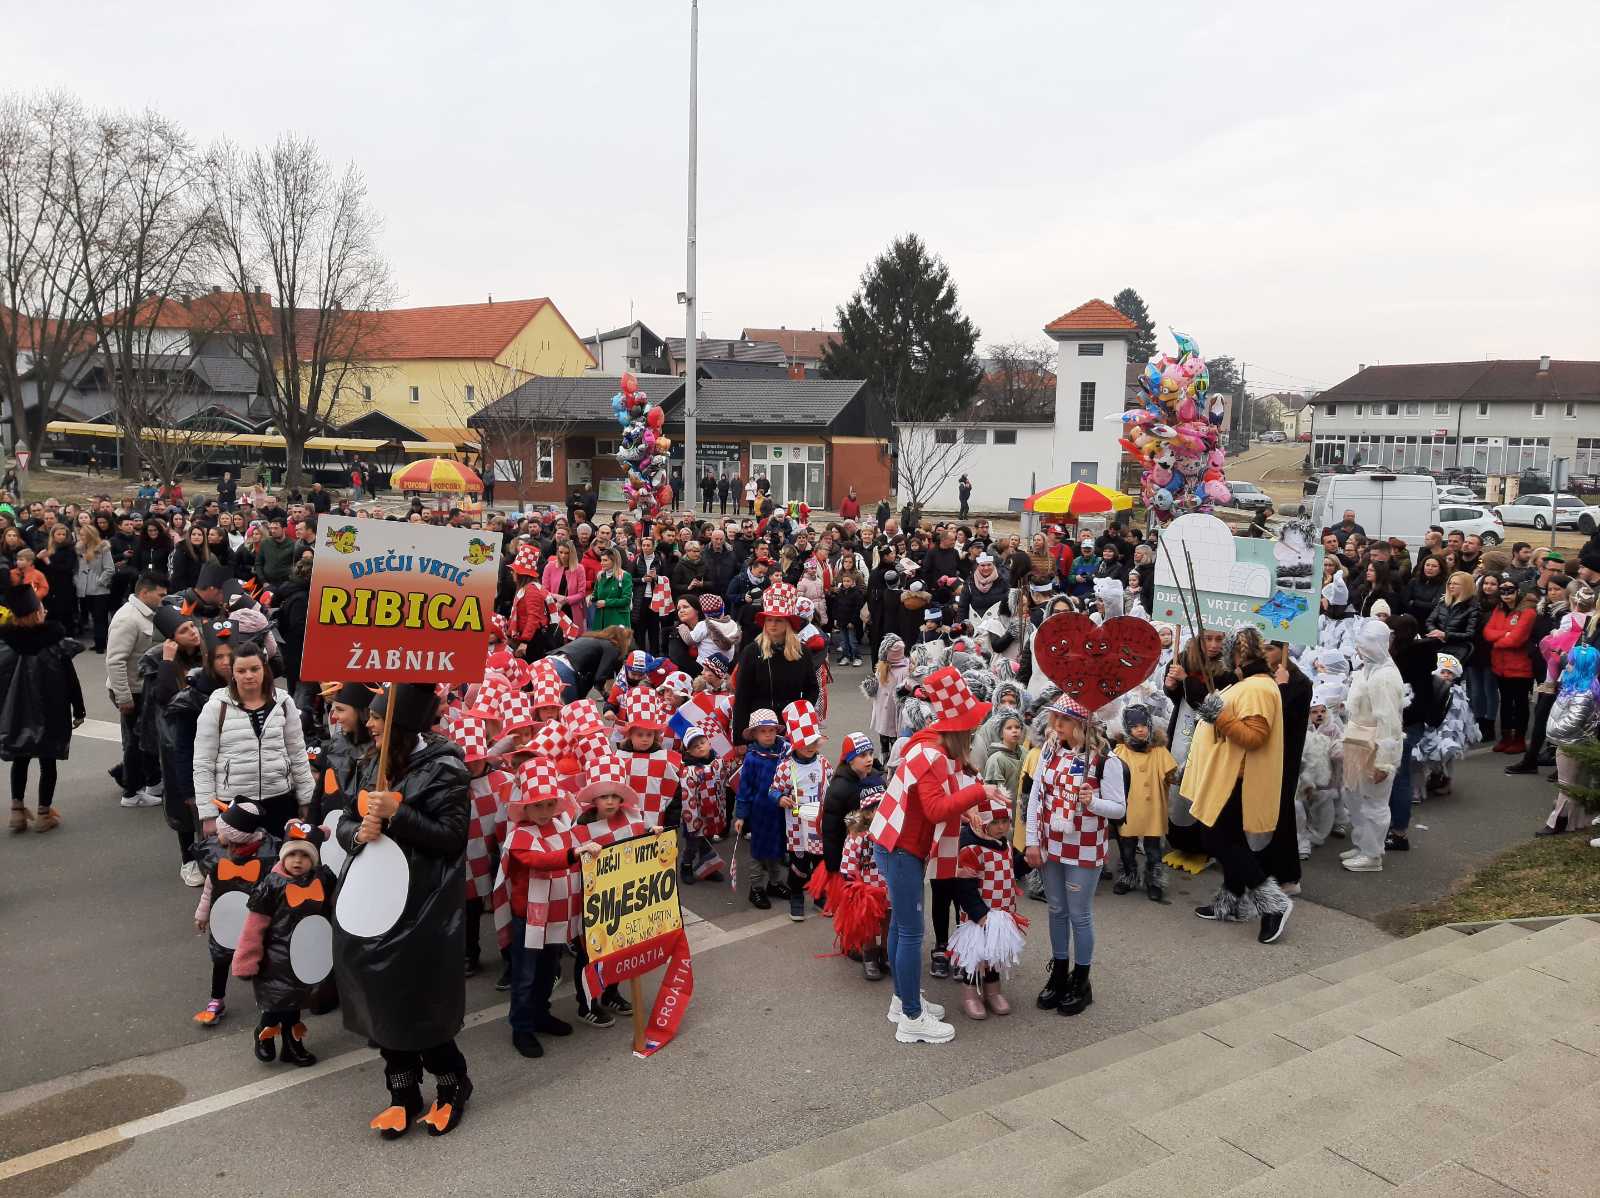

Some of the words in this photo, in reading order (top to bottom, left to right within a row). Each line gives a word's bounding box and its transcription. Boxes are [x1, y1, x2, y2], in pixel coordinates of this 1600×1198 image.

[349, 550, 413, 580] DJEČJI
[418, 556, 473, 587] VRTIĆ
[319, 586, 485, 632] RIBICA
[1207, 598, 1249, 613] VRTIĆ
[346, 643, 456, 671] ŽABNIK
[596, 848, 621, 877] DJEČJI
[616, 945, 665, 974] CROATIA
[656, 958, 692, 1027] CROATIA
